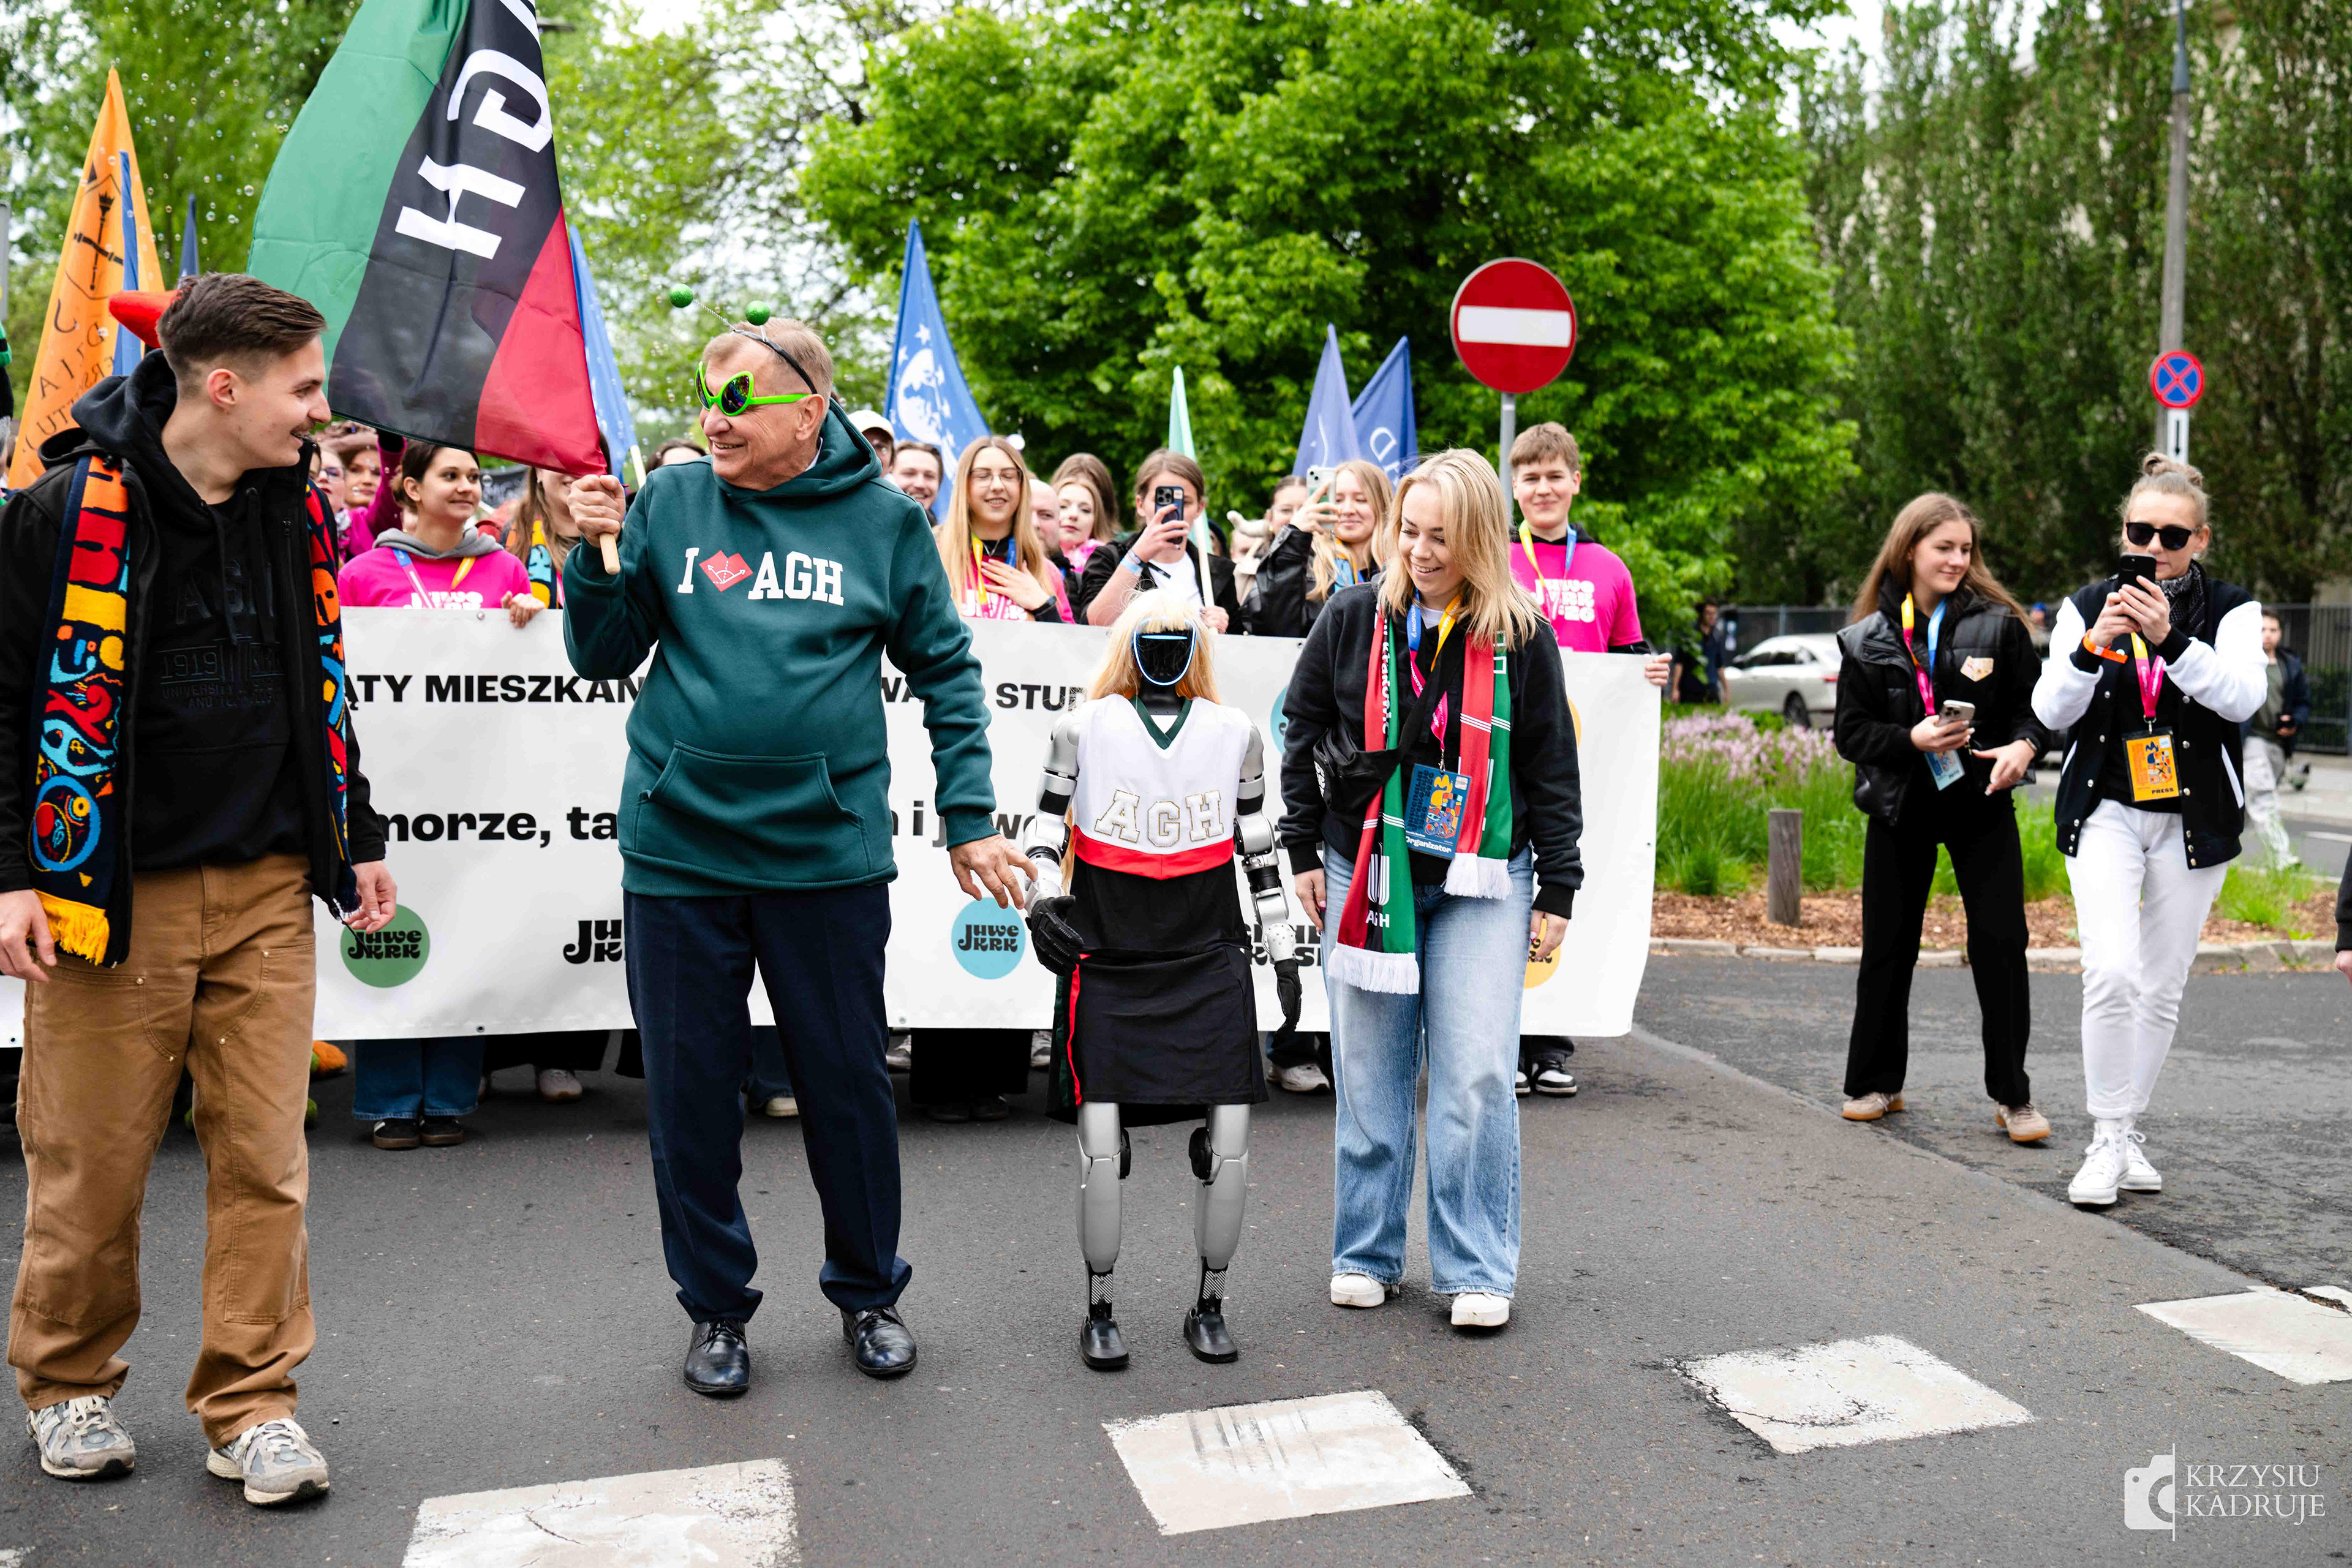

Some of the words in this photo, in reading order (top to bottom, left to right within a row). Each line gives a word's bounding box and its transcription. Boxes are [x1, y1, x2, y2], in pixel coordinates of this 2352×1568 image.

[677, 547, 699, 594] I
[748, 551, 844, 606] AGH
[160, 652, 217, 678] 1919
[1094, 789, 1224, 847] AGH
